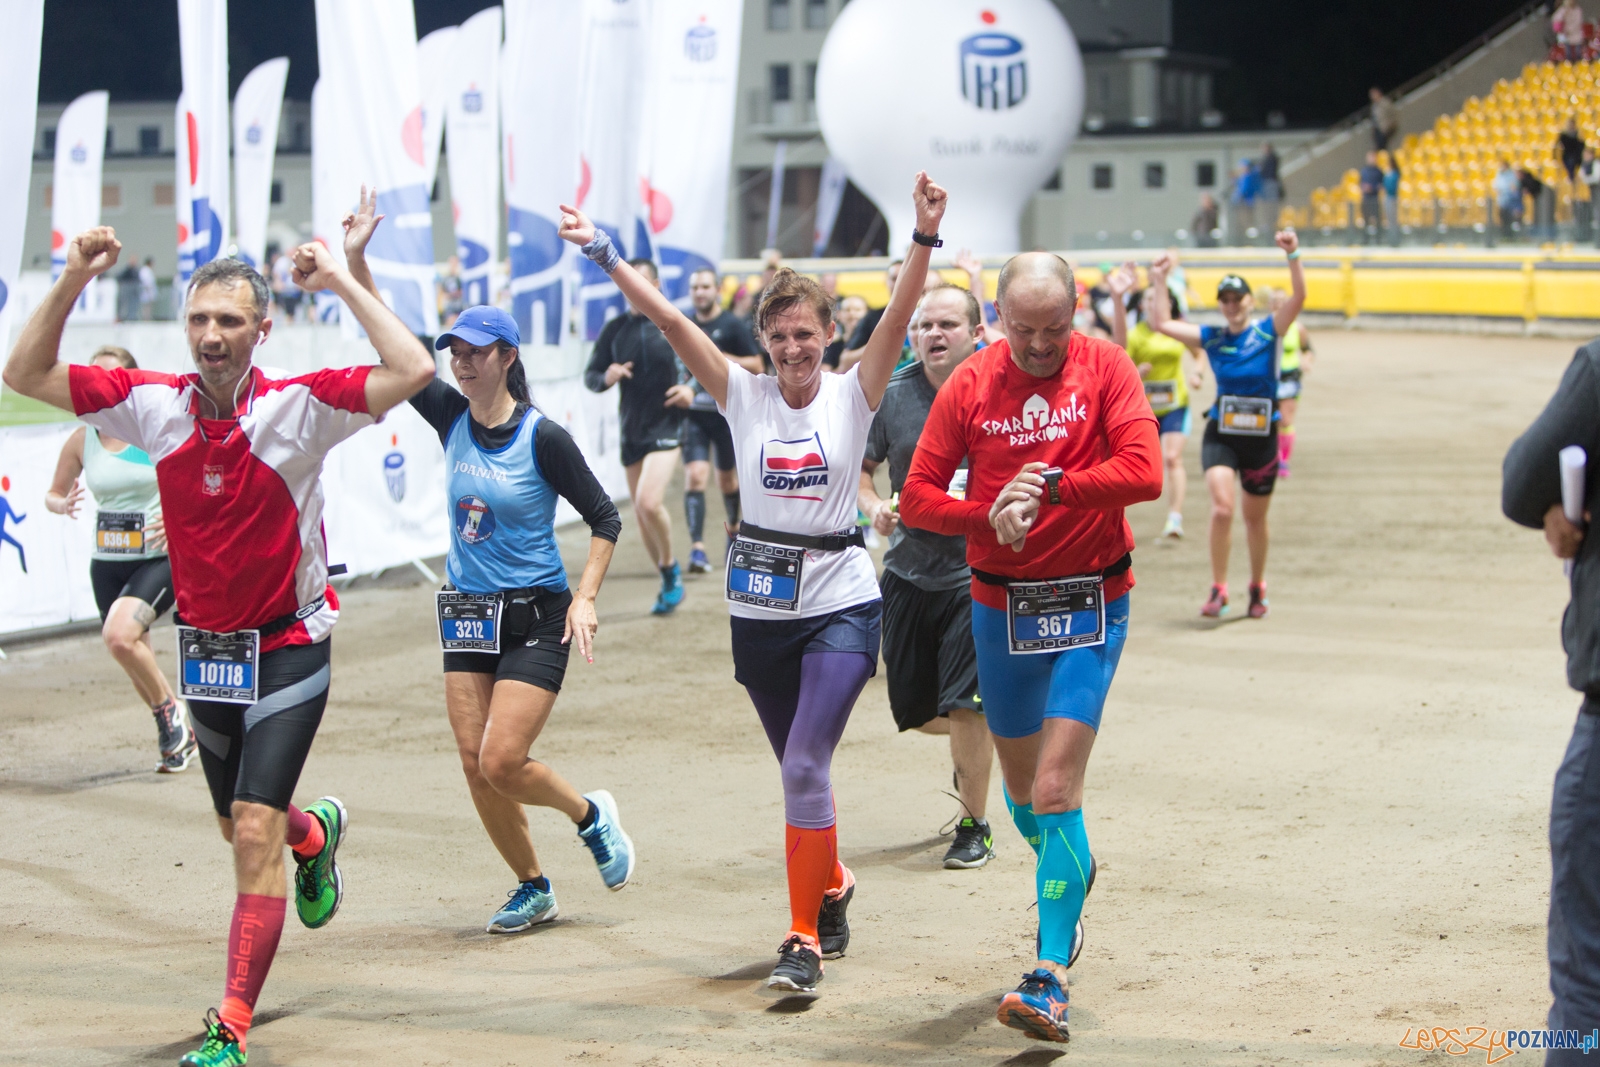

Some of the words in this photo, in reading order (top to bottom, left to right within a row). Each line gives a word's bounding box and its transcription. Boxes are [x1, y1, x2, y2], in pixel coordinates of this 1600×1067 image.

[453, 460, 508, 482] JOANNA
[763, 474, 828, 491] GDYNIA
[103, 532, 130, 547] 6364
[748, 573, 773, 595] 156
[455, 620, 484, 639] 3212
[1037, 614, 1072, 637] 367
[199, 662, 243, 687] 10118
[228, 912, 264, 992] kalenji
